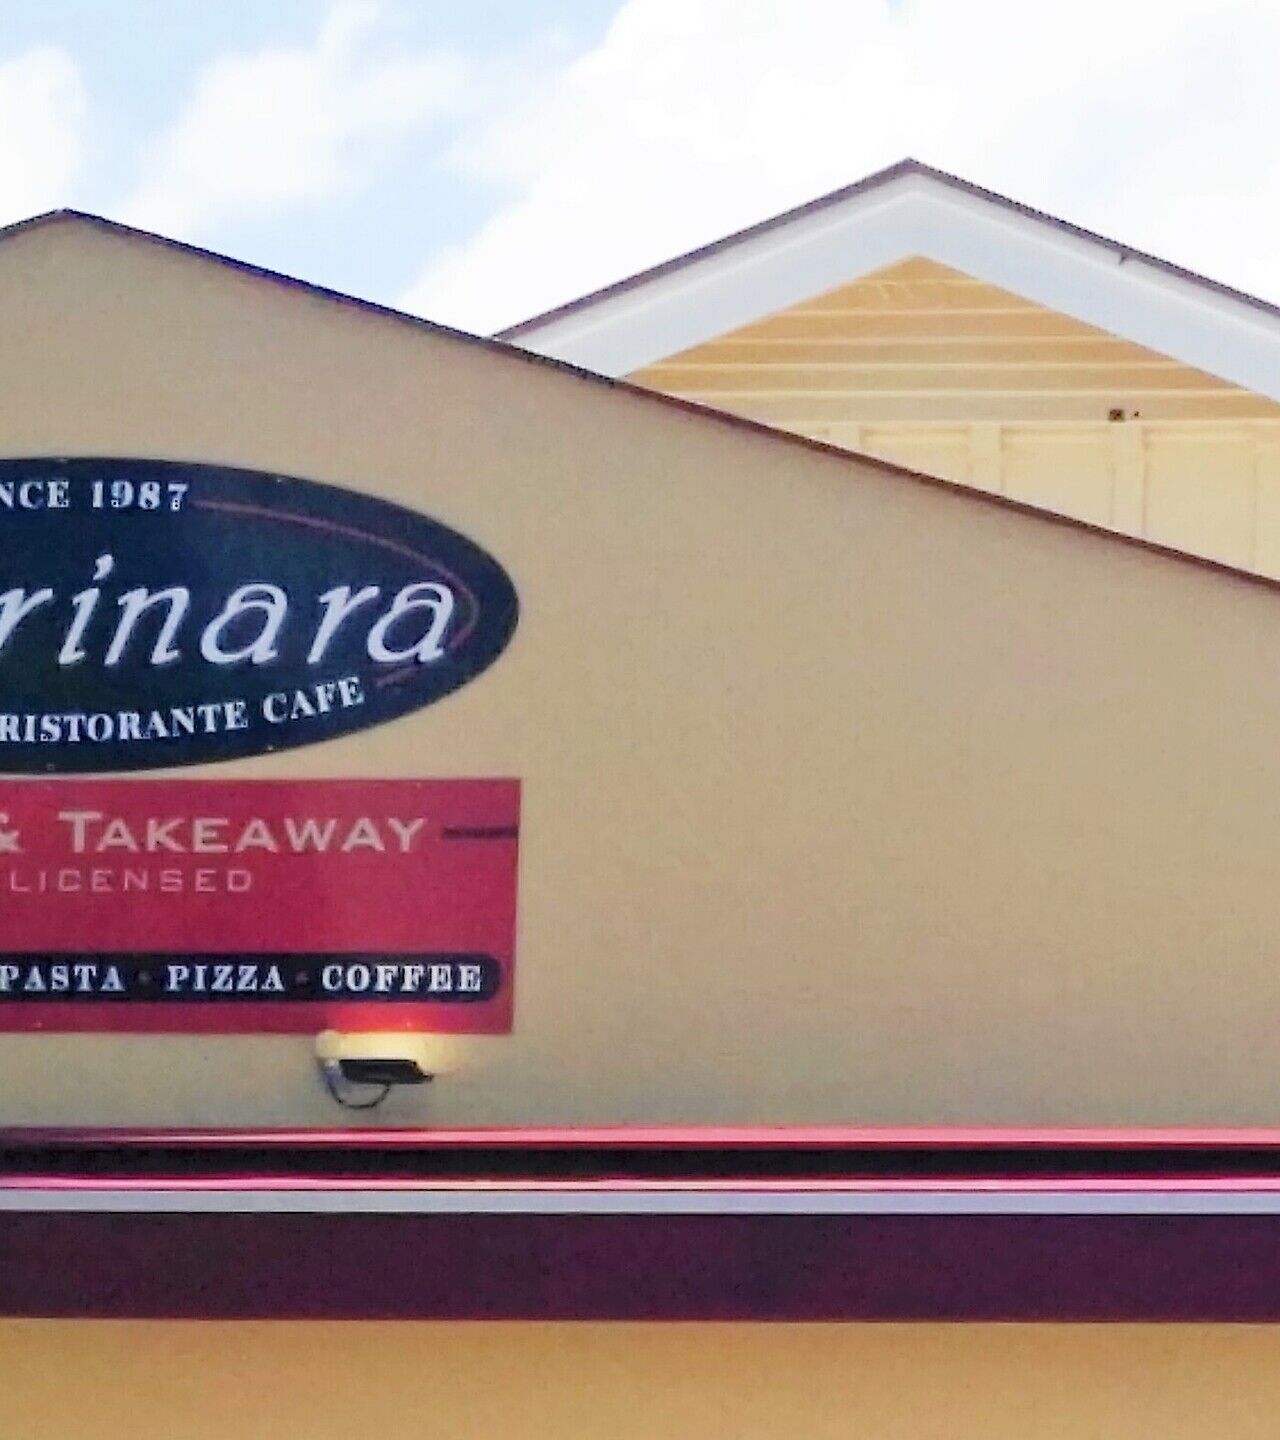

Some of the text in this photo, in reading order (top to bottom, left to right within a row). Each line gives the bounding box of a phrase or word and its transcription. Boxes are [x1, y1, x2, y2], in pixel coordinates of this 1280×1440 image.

[91, 481, 188, 512] 1987
[261, 676, 364, 725] CAFE
[59, 811, 425, 853] TAKEAWAY
[10, 868, 254, 893] LICENSED
[167, 963, 286, 992] PIZZA
[322, 962, 483, 992] COFFEE
